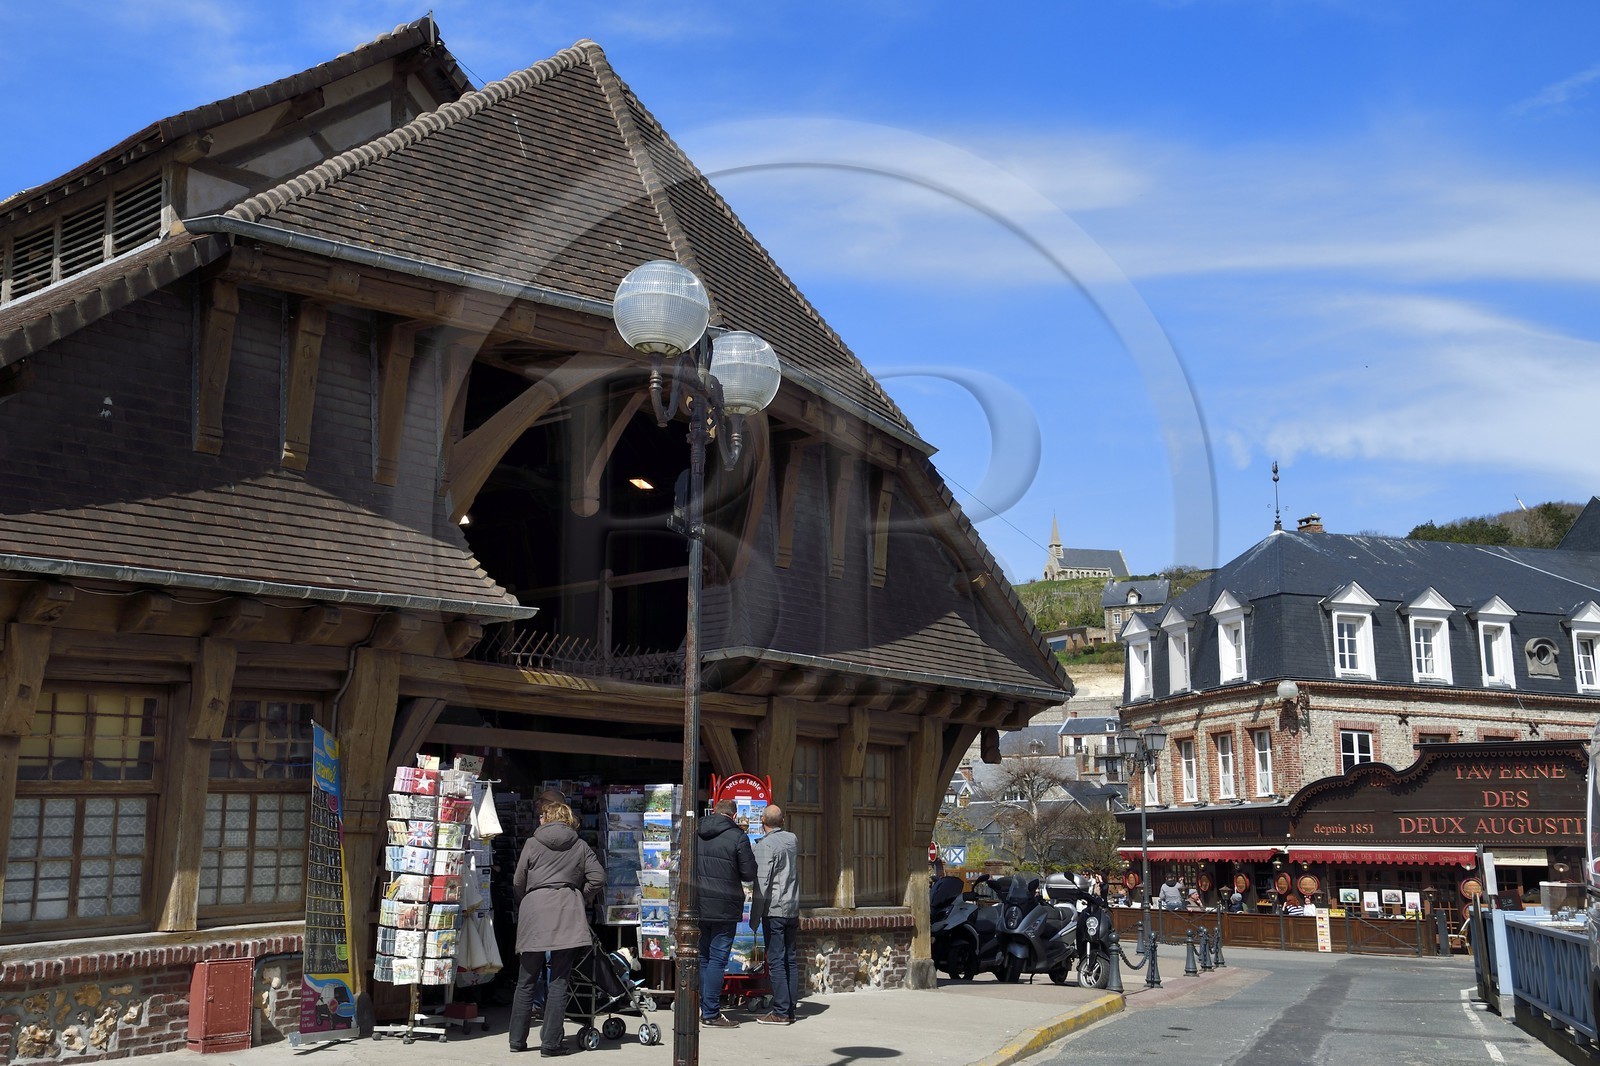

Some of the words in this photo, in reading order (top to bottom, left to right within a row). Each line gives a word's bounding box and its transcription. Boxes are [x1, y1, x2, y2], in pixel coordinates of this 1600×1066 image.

[1455, 763, 1567, 780] TAVERNE
[1482, 790, 1530, 808] DES
[1223, 819, 1258, 834] HOTEL
[1313, 823, 1347, 836] depuis
[1350, 823, 1375, 834] 1851
[1398, 817, 1467, 835] DEUX
[1474, 817, 1587, 835] AUGUSTI
